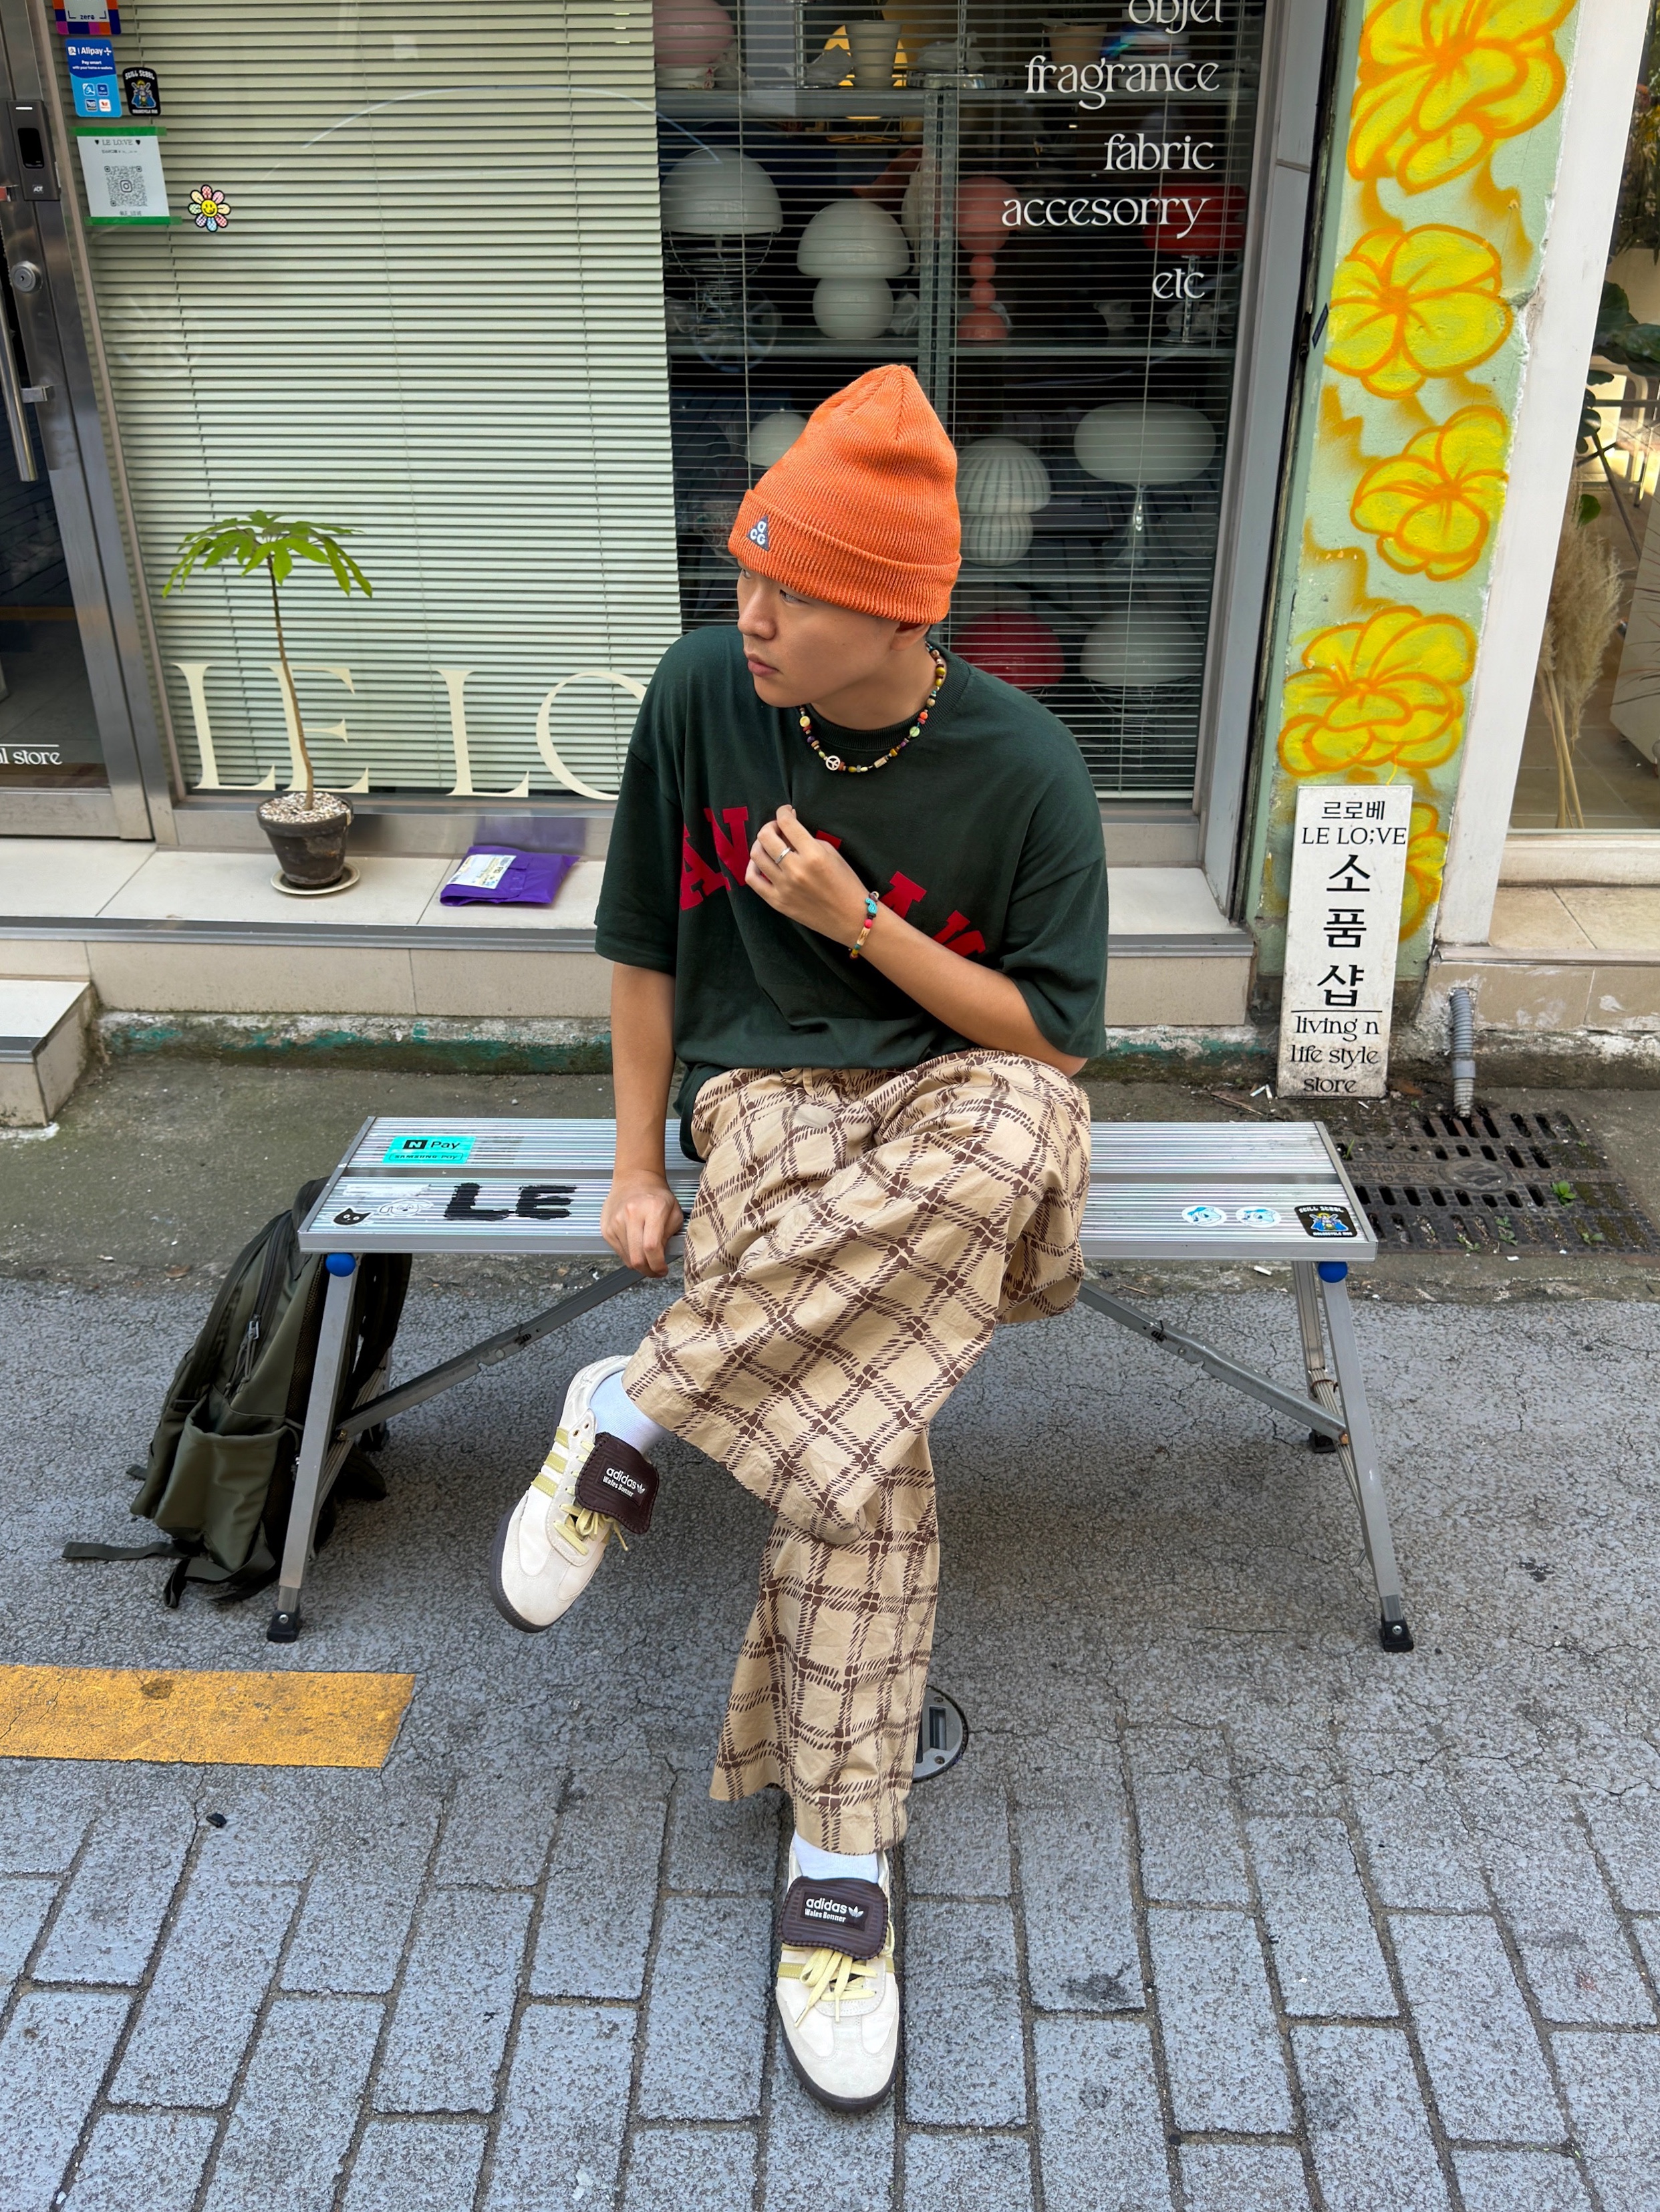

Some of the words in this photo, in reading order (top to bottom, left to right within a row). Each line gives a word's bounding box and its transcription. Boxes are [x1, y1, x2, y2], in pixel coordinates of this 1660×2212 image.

[1024, 55, 1220, 110] fragrance
[1103, 133, 1215, 171] fabric
[1002, 198, 1212, 240] accesorry
[1152, 268, 1206, 299] etc
[171, 662, 370, 794] LE
[12, 749, 63, 765] store
[1321, 801, 1385, 821] 르로베
[1301, 827, 1330, 845] LE
[1336, 827, 1407, 845] LO;VE
[1317, 853, 1371, 1007] 소품샵
[1294, 1016, 1358, 1042] living
[1364, 1021, 1381, 1034] n
[1288, 1045, 1323, 1063] life
[1329, 1046, 1379, 1070] style
[1303, 1077, 1357, 1093] store
[430, 1141, 460, 1149] Pay
[443, 1182, 577, 1222] LE
[603, 1476, 618, 1488] Wales
[618, 1484, 634, 1497] Bonner
[606, 1468, 637, 1490] adidas
[805, 1908, 823, 1918] Wales
[823, 1911, 847, 1923] Bonner
[806, 1898, 847, 1914] adidas
